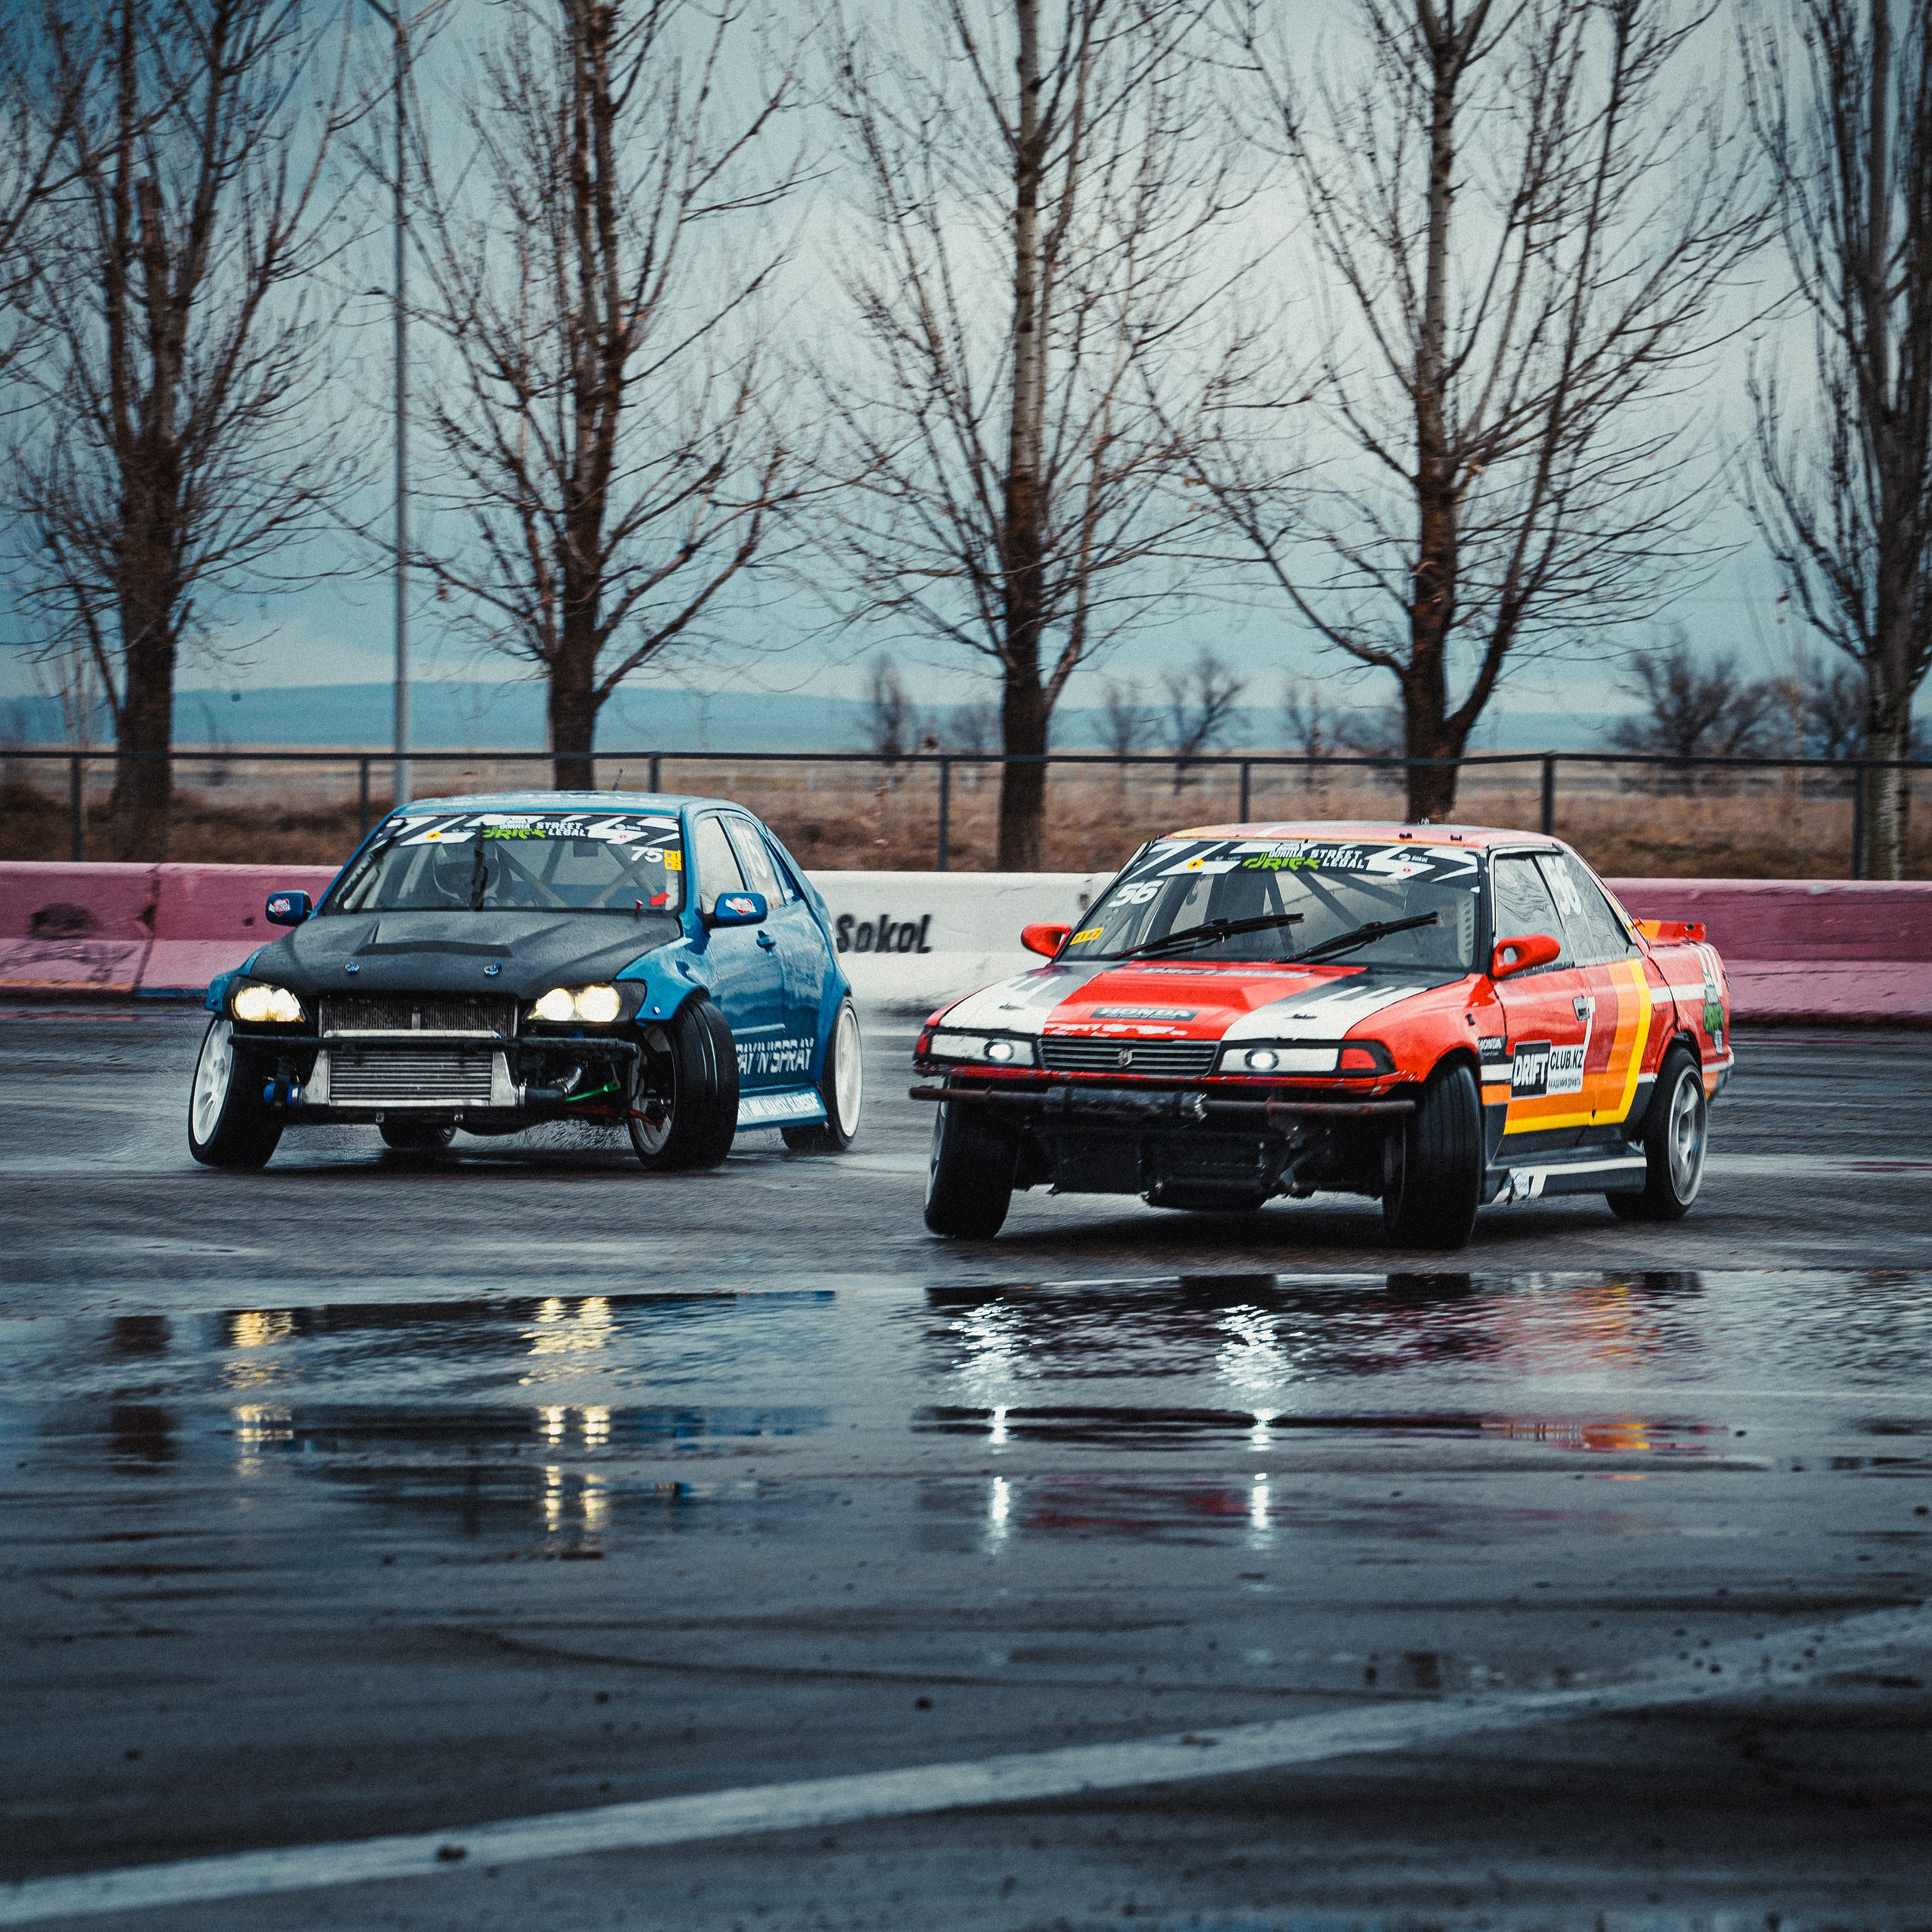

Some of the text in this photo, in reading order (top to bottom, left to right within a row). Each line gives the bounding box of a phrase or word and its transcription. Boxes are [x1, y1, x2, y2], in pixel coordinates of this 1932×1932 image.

[548, 829, 586, 837] LEGAL
[631, 846, 664, 863] 75
[1309, 849, 1363, 860] STREET
[1321, 857, 1364, 869] LEGAL
[1540, 855, 1581, 915] 56
[1107, 880, 1164, 908] 56
[1098, 1007, 1192, 1018] HONDA
[1513, 1050, 1584, 1087] DRIFT CLUB.KZ
